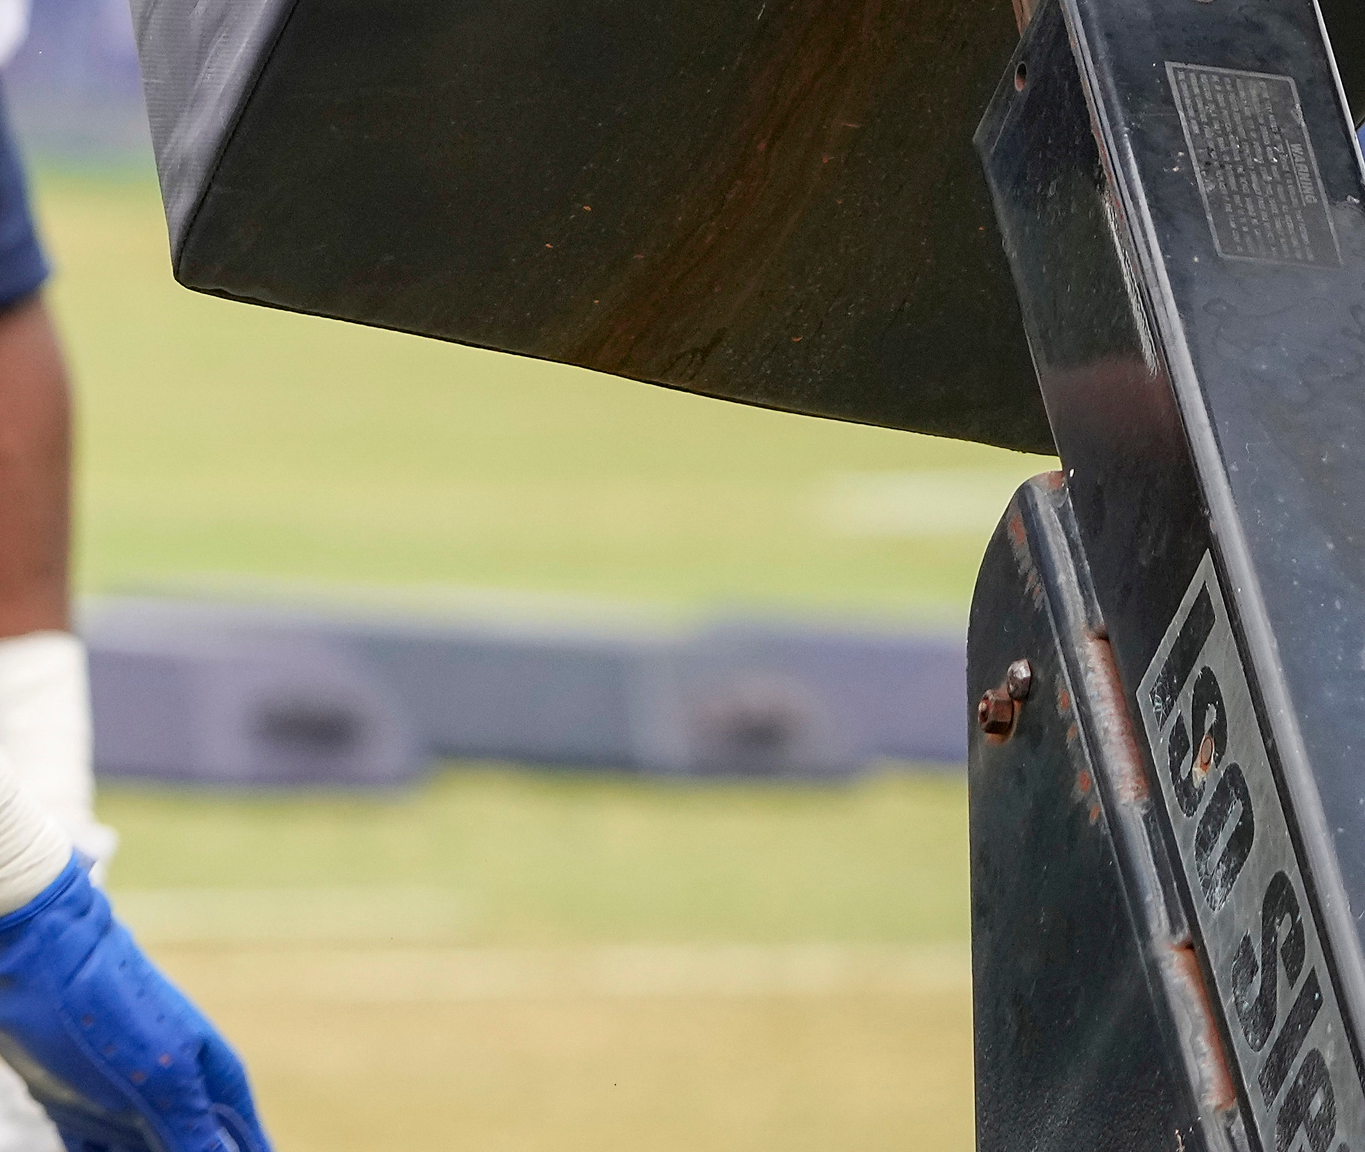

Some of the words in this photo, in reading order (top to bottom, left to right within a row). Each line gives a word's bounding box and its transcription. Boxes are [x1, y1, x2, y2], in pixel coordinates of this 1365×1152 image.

[1290, 143, 1317, 203] WARNING
[1150, 581, 1255, 912] Iso
[1231, 870, 1351, 1152] Sle
